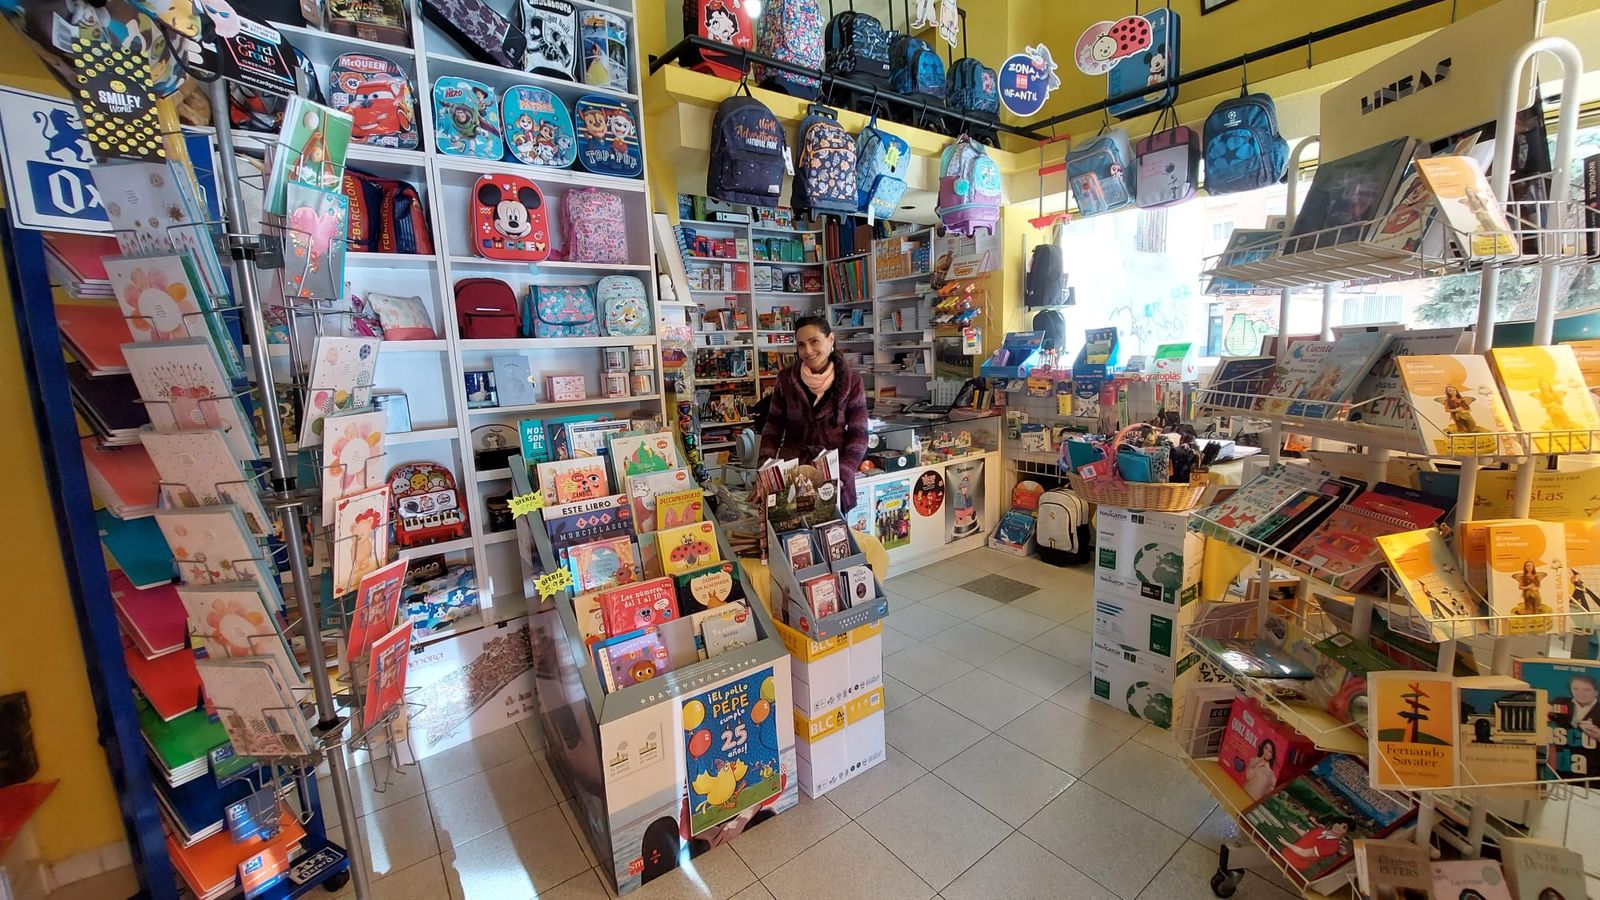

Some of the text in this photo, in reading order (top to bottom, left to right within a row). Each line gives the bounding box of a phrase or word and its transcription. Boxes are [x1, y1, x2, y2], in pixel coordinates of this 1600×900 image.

[236, 35, 273, 57] Card
[237, 45, 276, 66] Group
[341, 58, 386, 71] McQUEEN
[1008, 63, 1036, 75] ZONA
[1004, 88, 1038, 101] INFANTIL
[1361, 57, 1452, 116] LINEAS
[98, 90, 141, 109] SMILEY
[585, 149, 638, 169] TOP PUP
[533, 441, 543, 450] EL
[514, 495, 537, 506] OFERTA
[562, 500, 611, 515] ESTE LIBRO
[541, 572, 563, 586] OFERTA
[620, 586, 663, 602] Los números
[623, 600, 635, 609] del
[643, 595, 651, 603] al
[653, 592, 662, 600] 10
[725, 683, 748, 700] pollo
[712, 693, 750, 719] PEPE
[719, 708, 746, 725] cumple
[810, 715, 835, 737] BLC
[1231, 717, 1246, 738] QUIZ
[1244, 729, 1259, 748] BOX
[720, 723, 748, 752] 25
[727, 742, 748, 758] años!
[1386, 743, 1445, 758] Fernando
[1392, 756, 1439, 768] Savater
[1378, 864, 1419, 878] PETERS
